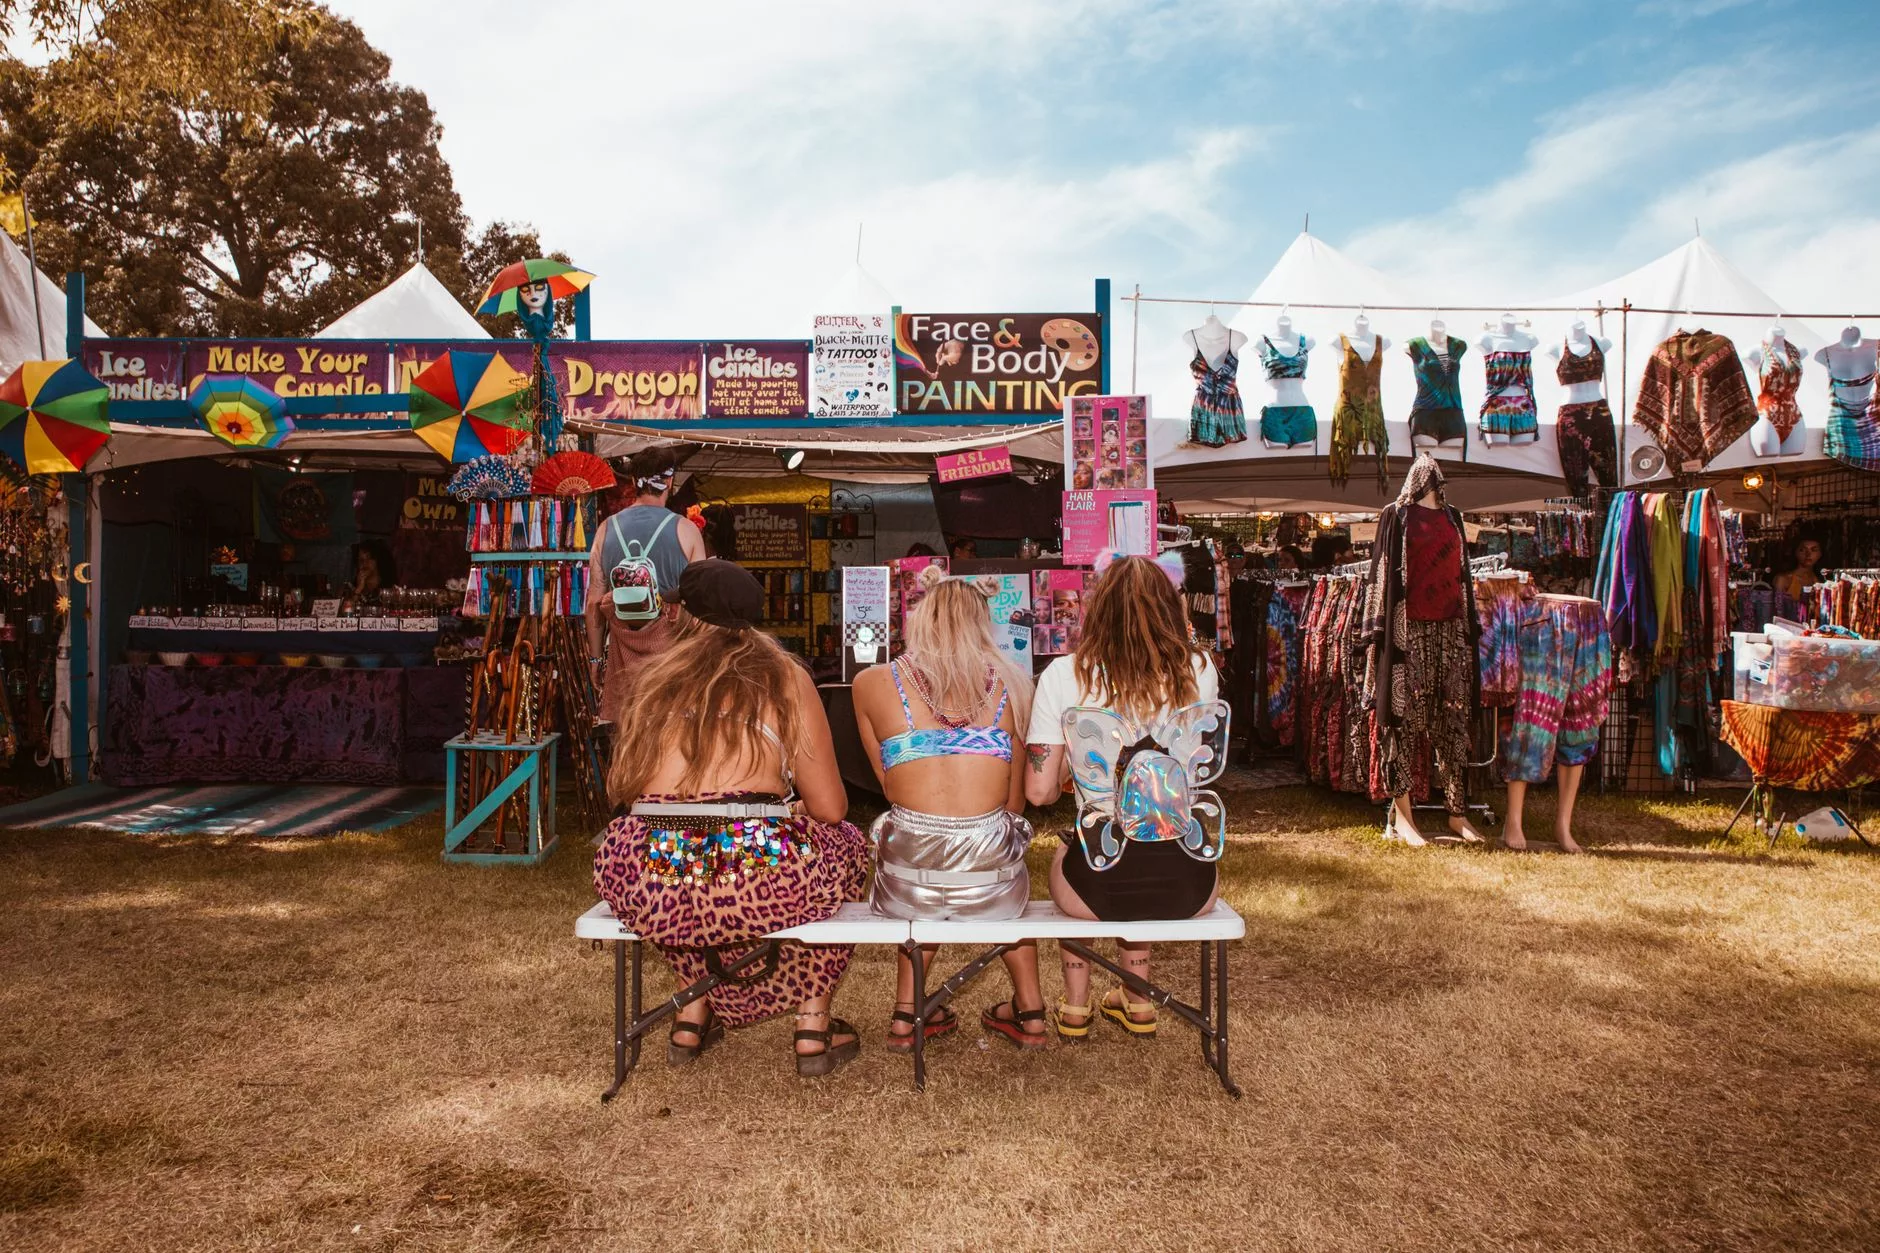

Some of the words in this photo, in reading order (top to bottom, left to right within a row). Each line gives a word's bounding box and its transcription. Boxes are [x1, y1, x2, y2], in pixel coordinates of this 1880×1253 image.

[815, 315, 865, 329] GLITTER
[815, 334, 889, 345] BLACK-MATTE
[911, 316, 990, 341] Face
[993, 318, 1022, 348] &
[723, 343, 757, 361] Ice
[827, 348, 878, 359] TATTOOS
[99, 350, 146, 377] Ice
[207, 346, 286, 374] Make
[296, 347, 369, 374] Your
[708, 356, 798, 378] Candles
[972, 344, 1070, 383] Body
[108, 377, 180, 400] andles
[274, 374, 383, 397] Candle
[564, 357, 699, 405] Dragon
[716, 380, 742, 388] Made
[746, 380, 757, 390] by
[761, 380, 798, 390] pouring
[712, 389, 729, 398] hot
[733, 390, 753, 398] wax
[756, 390, 780, 398] over
[783, 388, 801, 398] ice,
[709, 398, 736, 406] refill
[739, 398, 751, 406] at
[754, 398, 778, 406] home
[781, 397, 805, 406] with
[724, 406, 750, 415] stick
[753, 406, 790, 415] candles
[940, 458, 1011, 481] FRIENDLY!
[1069, 492, 1094, 501] HAIR
[403, 496, 457, 521] Own
[743, 505, 768, 518] Ice
[1065, 501, 1096, 511] FLAIR!
[733, 515, 798, 530] Candles
[401, 619, 418, 630] Love
